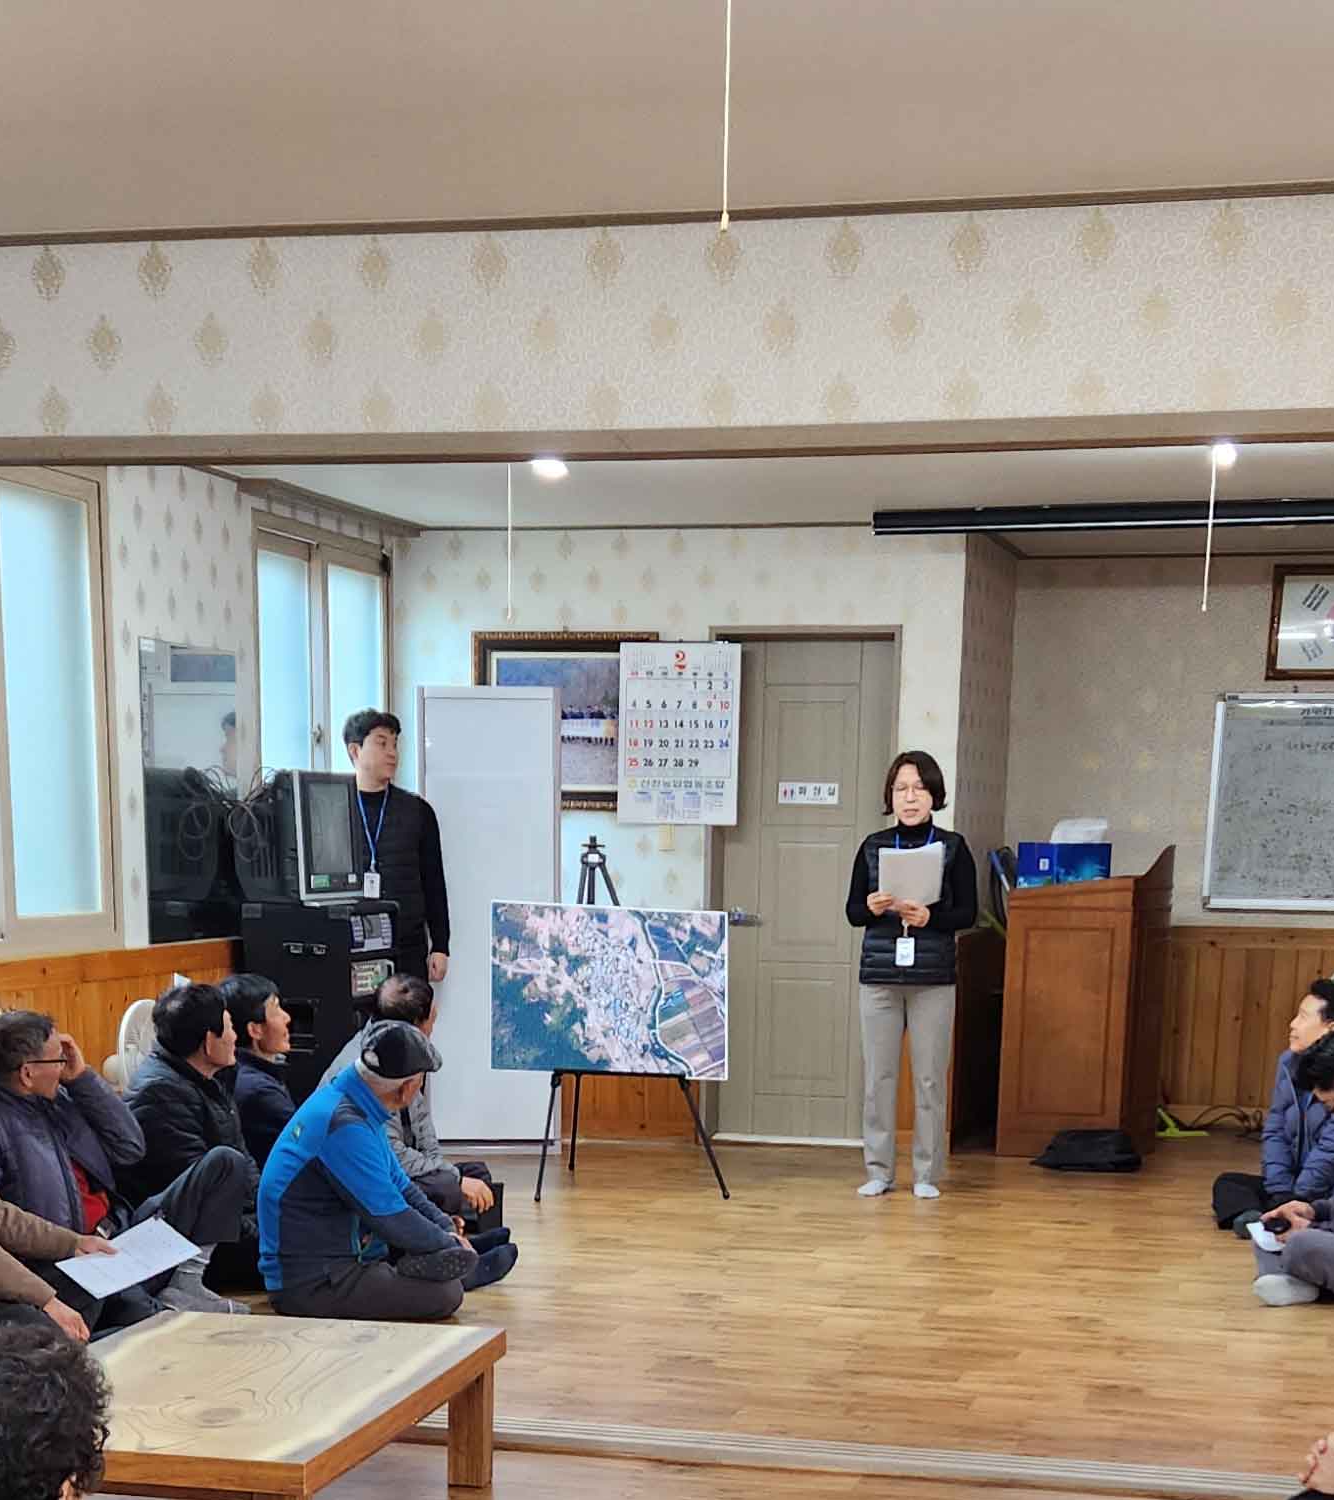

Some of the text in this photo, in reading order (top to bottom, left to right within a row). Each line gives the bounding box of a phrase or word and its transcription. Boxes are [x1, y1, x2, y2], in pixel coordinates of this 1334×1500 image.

[674, 650, 686, 671] 2
[720, 701, 730, 710] 10
[630, 720, 639, 728] 11
[644, 720, 653, 729] 12
[674, 720, 684, 729] 14
[689, 720, 699, 729] 15
[704, 720, 714, 729] 16
[719, 720, 729, 729] 17
[643, 739, 653, 748] 19
[659, 739, 669, 748] 20
[674, 739, 684, 748] 21
[688, 739, 699, 748] 22
[628, 758, 699, 767] 25 26 27 28 29
